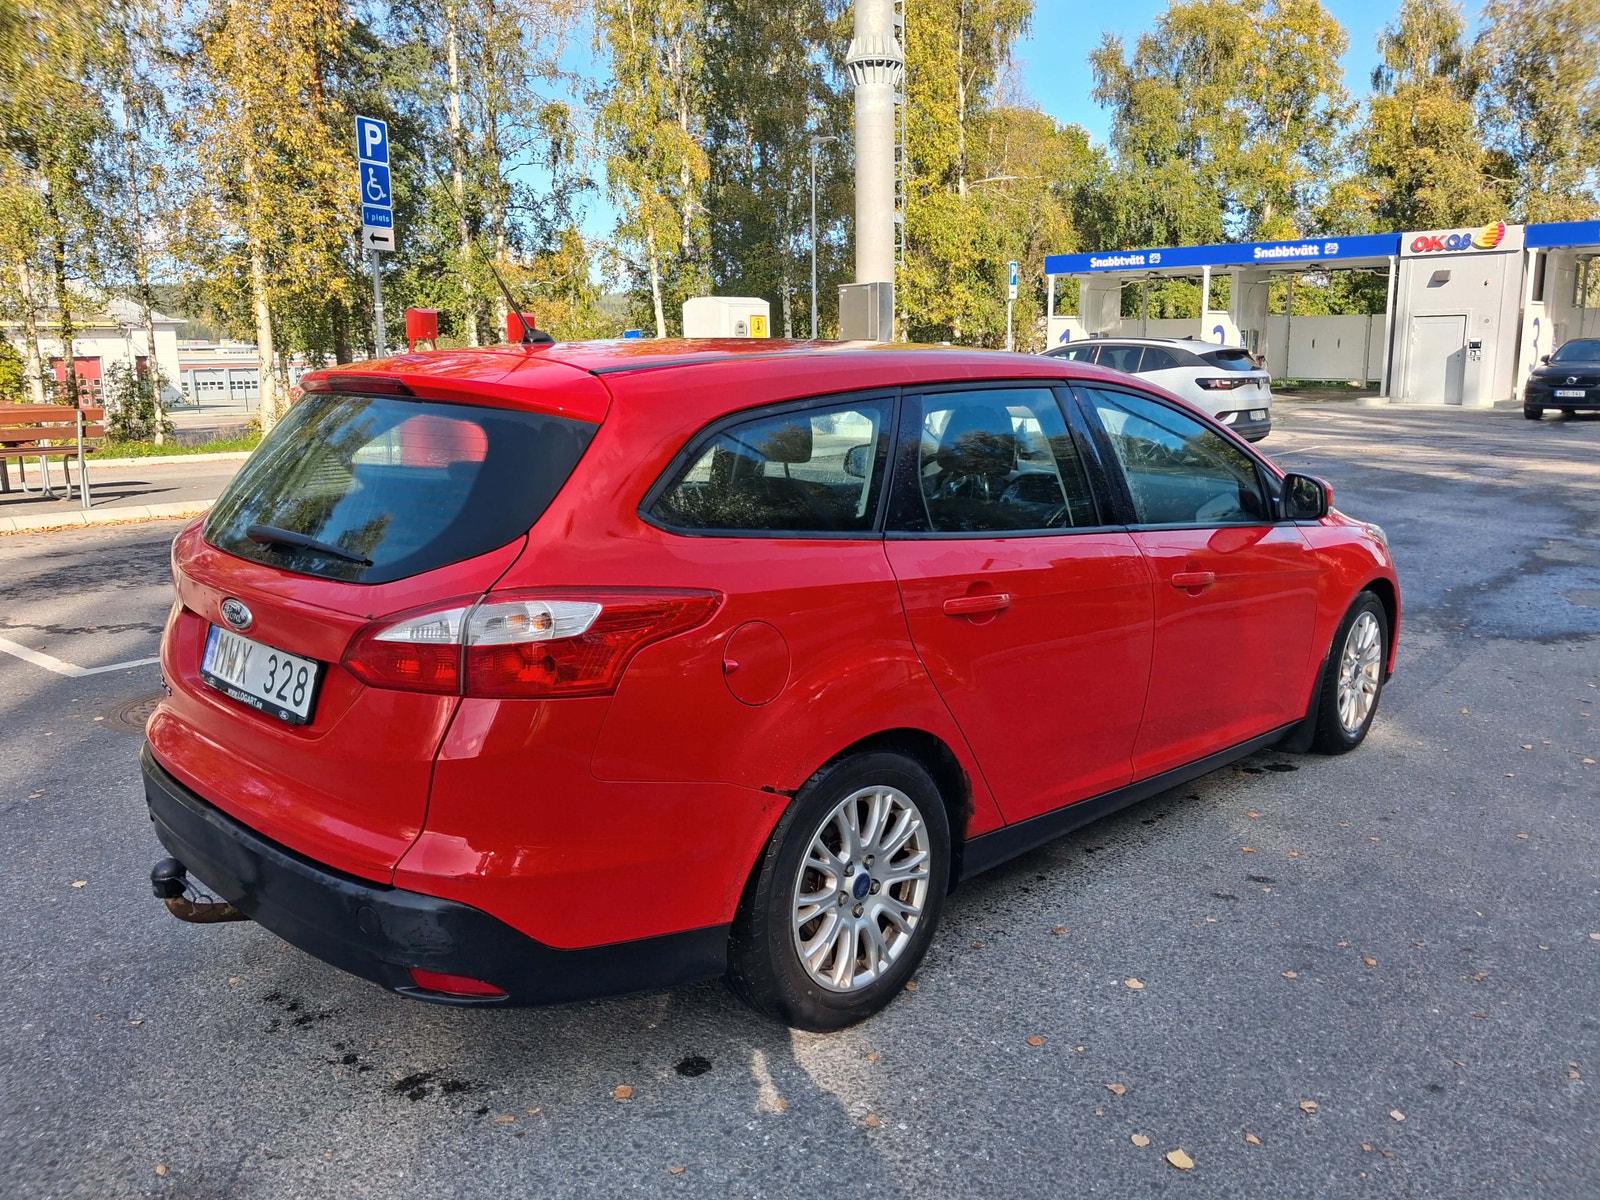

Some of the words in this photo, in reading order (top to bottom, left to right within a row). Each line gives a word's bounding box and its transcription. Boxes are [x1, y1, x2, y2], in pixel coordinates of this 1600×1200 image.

[364, 122, 382, 157] P
[371, 212, 390, 223] plats
[1253, 244, 1320, 259] Snabbtvätt
[1411, 233, 1472, 252] OKQ8
[1089, 254, 1145, 268] Snabbtvätt
[1011, 264, 1017, 284] P
[1528, 317, 1540, 373] 3
[213, 633, 253, 685] MWX
[263, 654, 309, 708] 328
